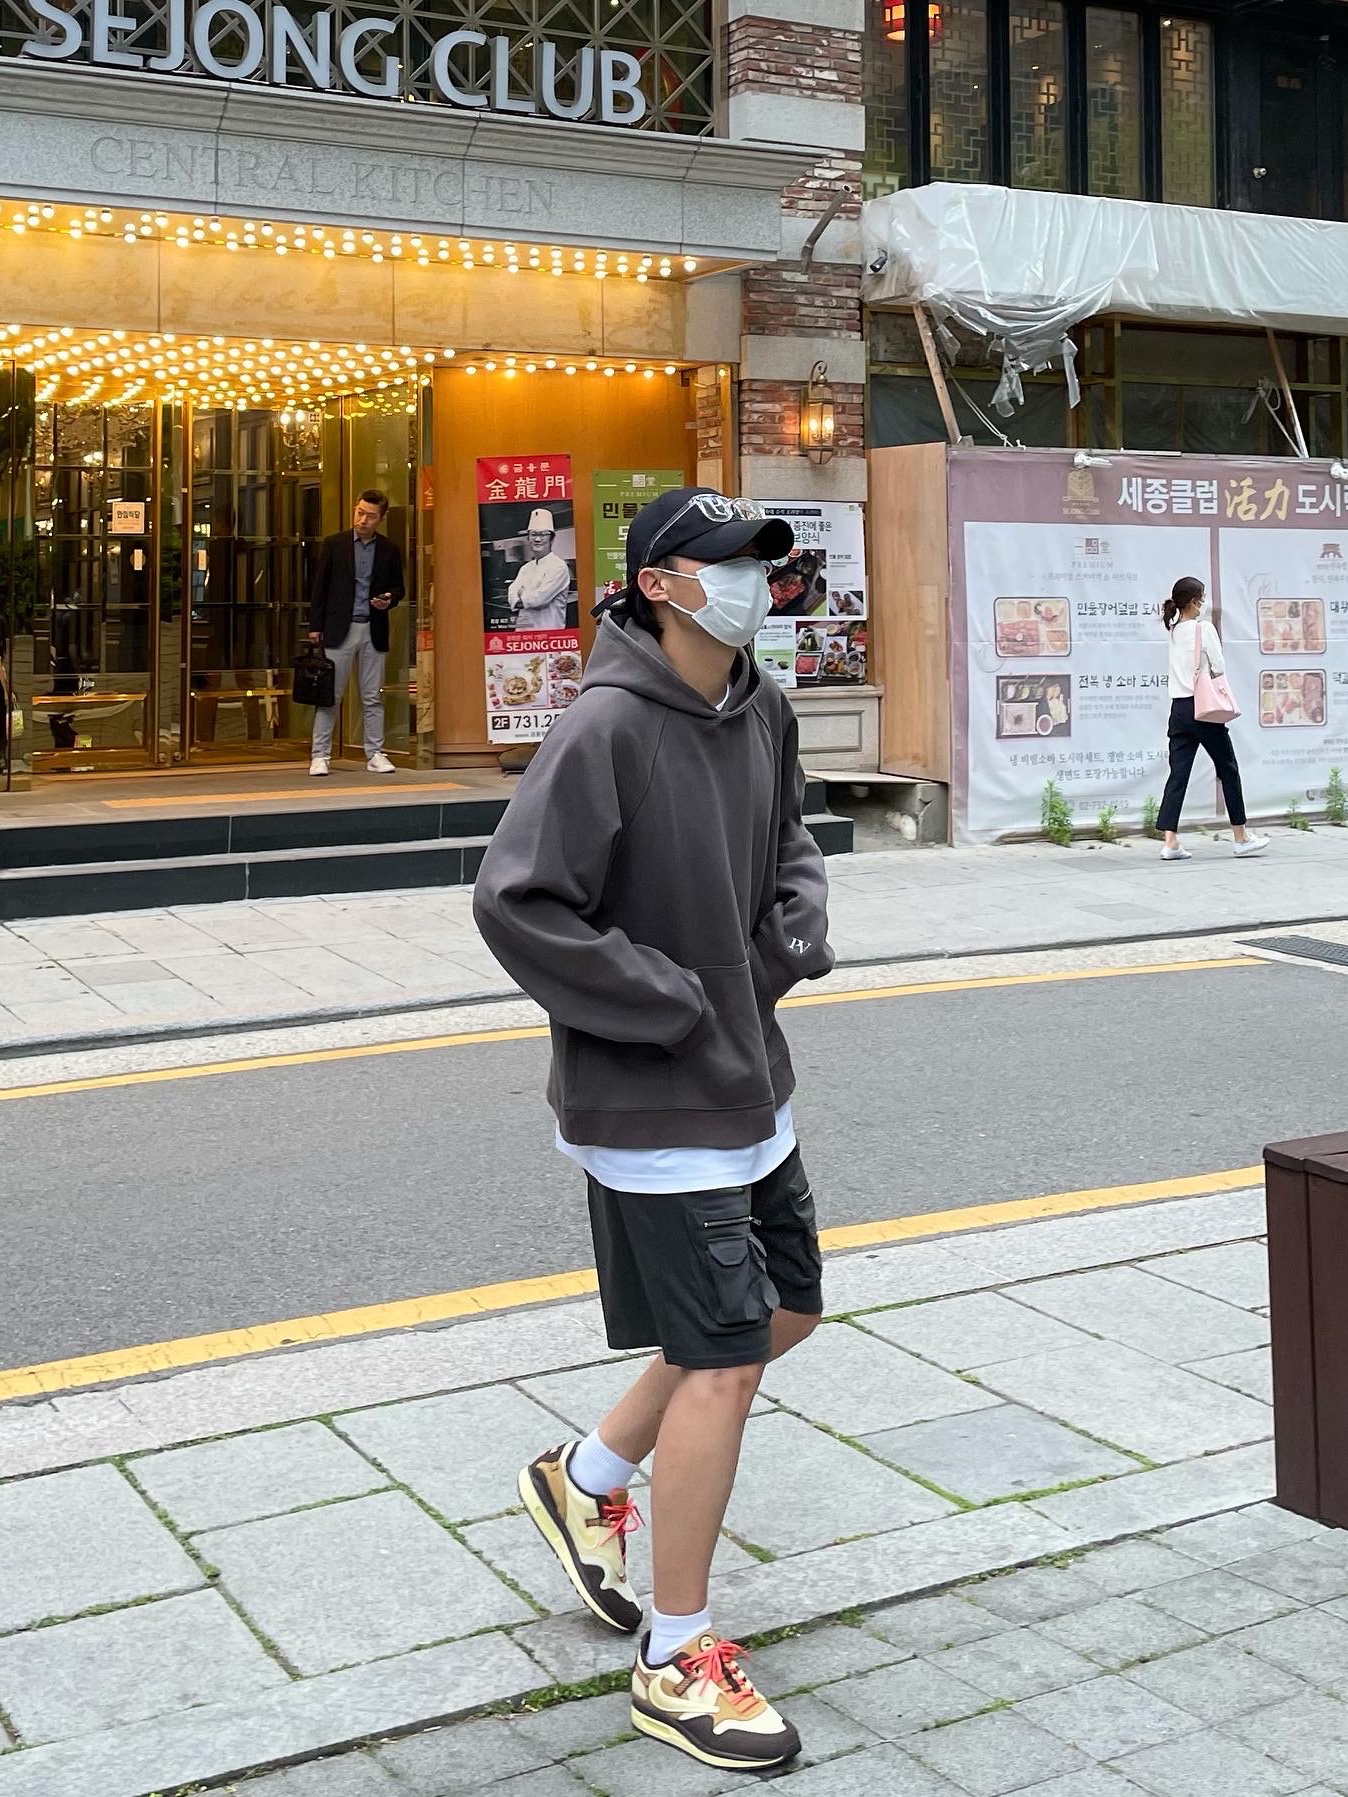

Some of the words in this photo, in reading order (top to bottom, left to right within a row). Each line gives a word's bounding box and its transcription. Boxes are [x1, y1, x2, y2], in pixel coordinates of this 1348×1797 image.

[22, 0, 399, 98] SEJONG
[432, 29, 646, 124] CLUB
[90, 135, 335, 194] CENTRAL
[350, 161, 556, 214] KITCHEN
[484, 475, 566, 500] 金龍門
[1117, 476, 1219, 515] 세종클럽
[1224, 477, 1291, 521] 活力
[602, 502, 649, 519] 민물
[819, 520, 832, 532] 좋은
[1077, 602, 1139, 616] 민물장어덮밥
[1141, 602, 1165, 616] 도시
[506, 640, 549, 652] SEJONG
[549, 638, 579, 650] CLUB
[1078, 675, 1100, 689] 전복
[1102, 675, 1113, 689] 냉
[1116, 675, 1137, 688] 소바
[1140, 675, 1169, 688] 도시락
[494, 717, 509, 729] 2F
